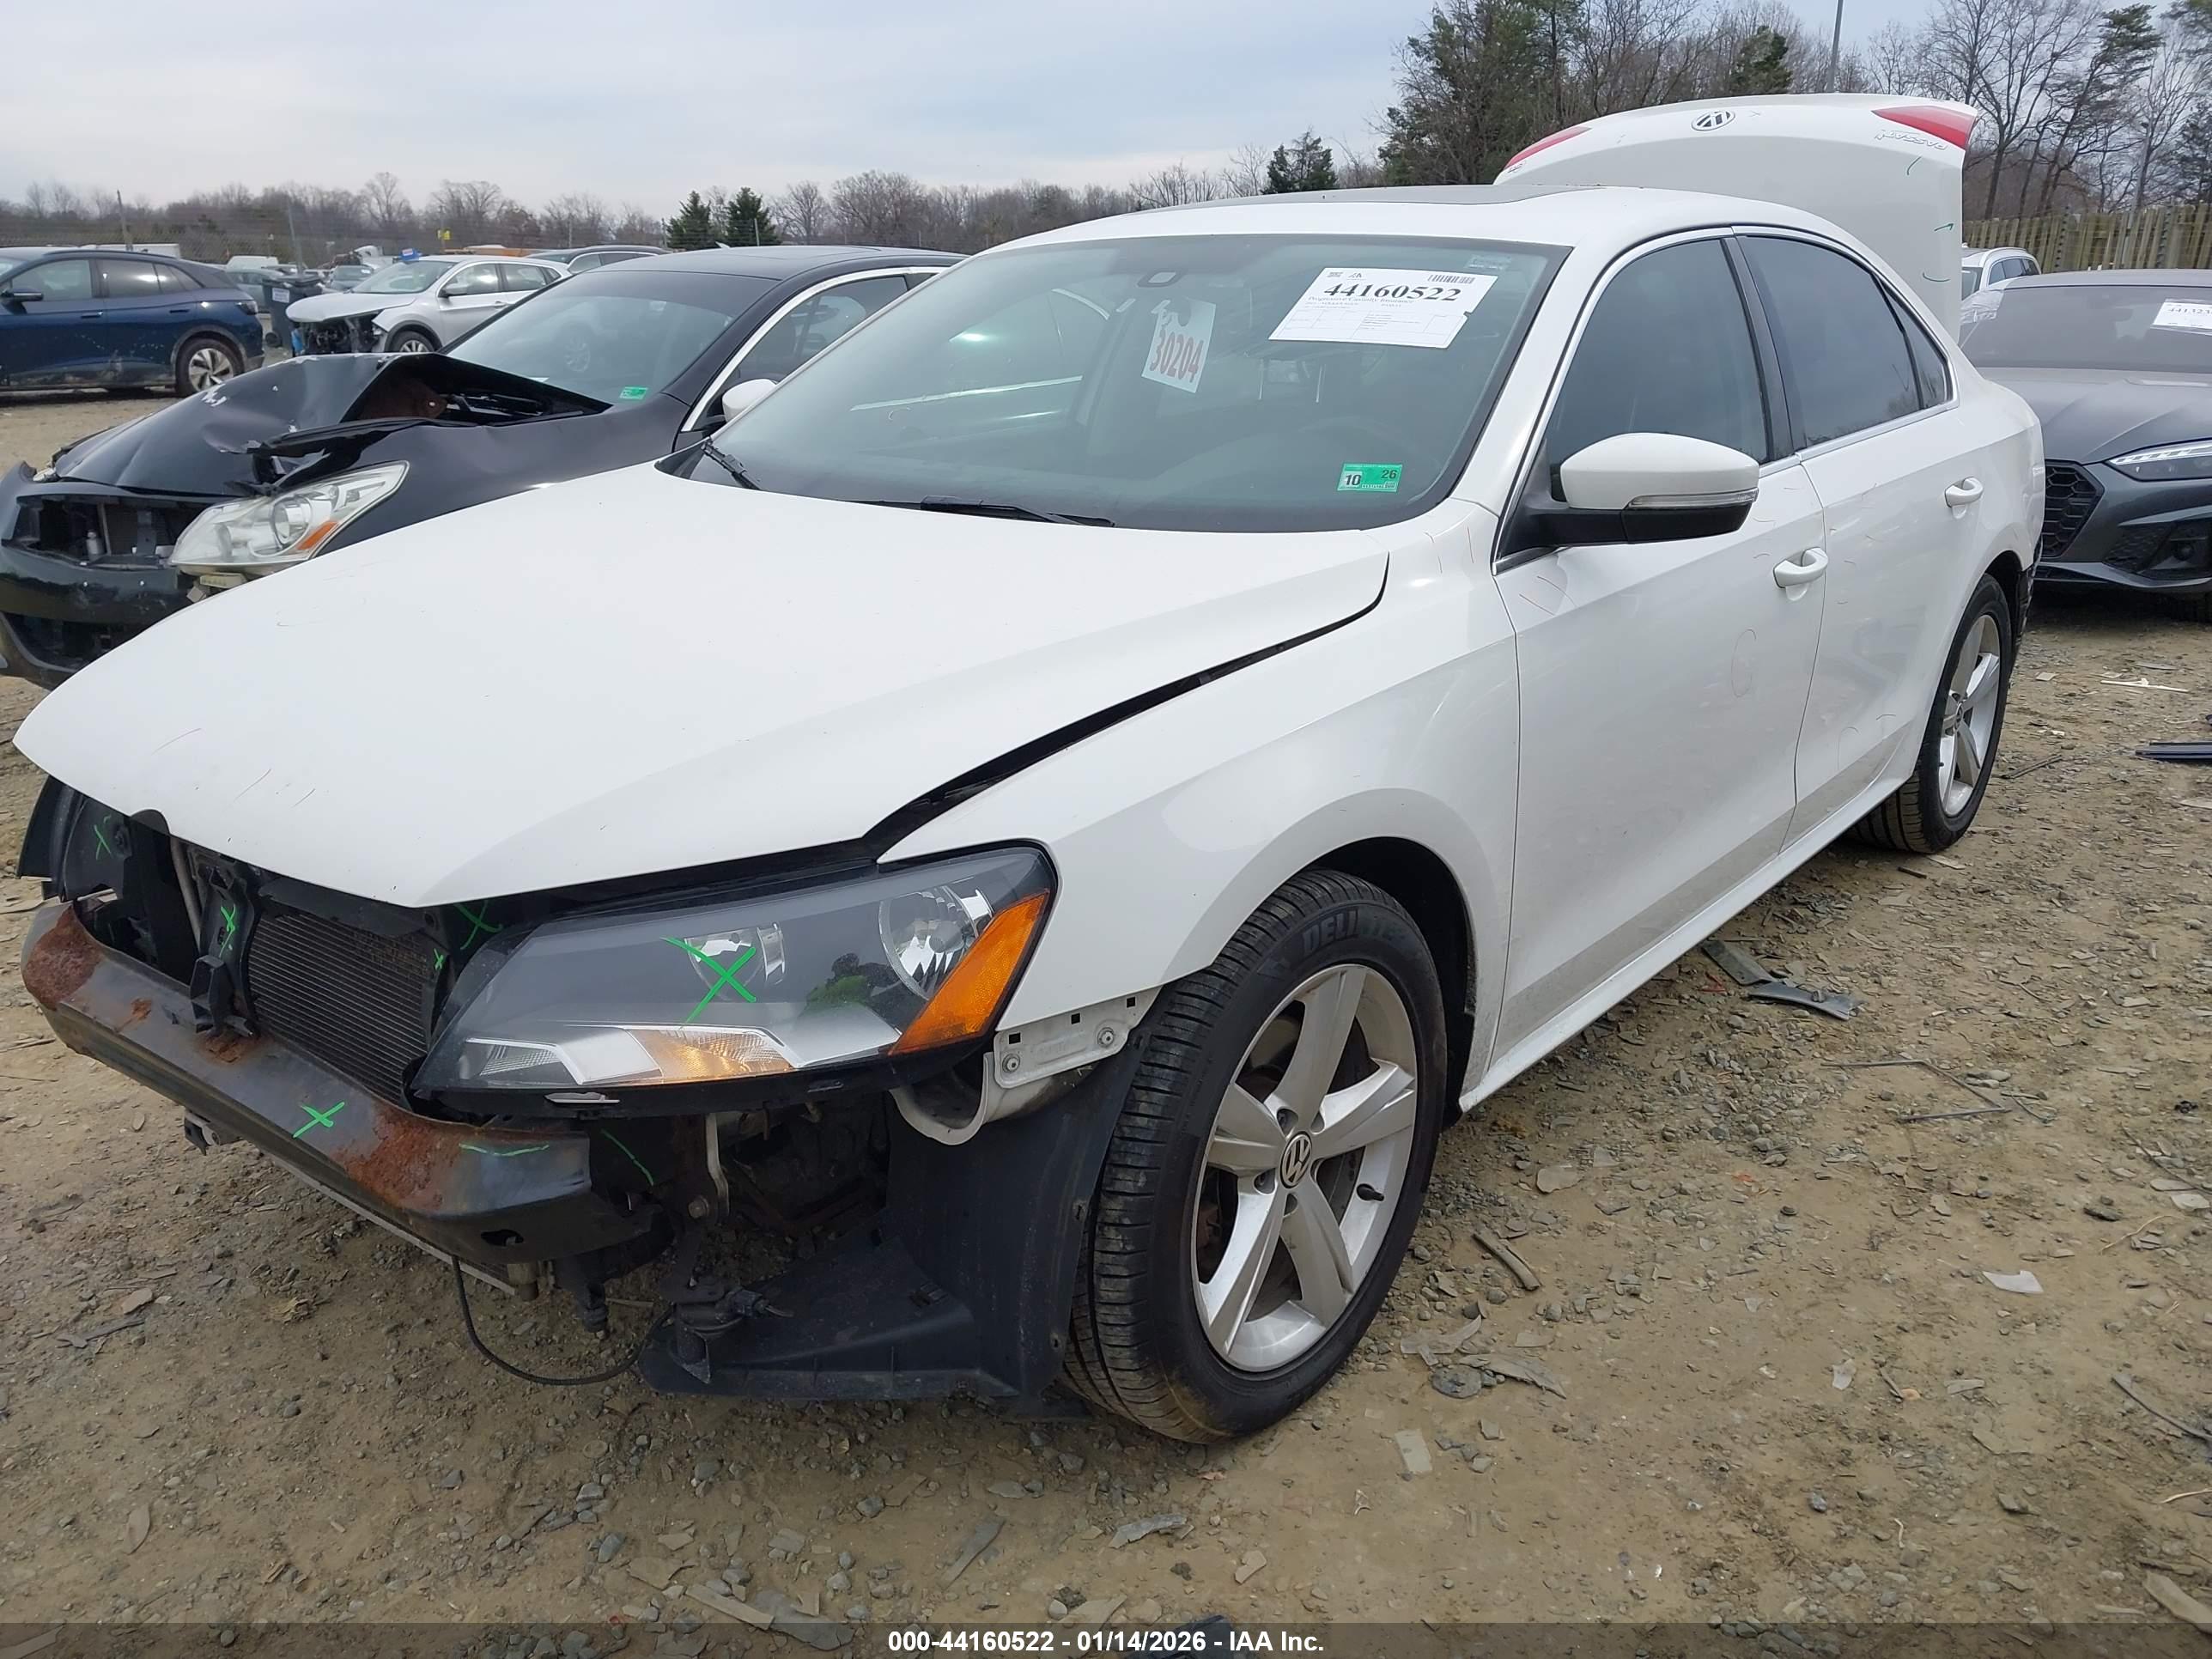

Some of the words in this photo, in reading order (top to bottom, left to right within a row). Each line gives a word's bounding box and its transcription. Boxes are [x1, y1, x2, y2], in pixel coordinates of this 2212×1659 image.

[1874, 129, 1948, 150] PASSAT
[1323, 283, 1462, 301] 44160522
[1149, 327, 1204, 383] 30204
[1345, 474, 1362, 486] 10
[1381, 469, 1398, 479] 26
